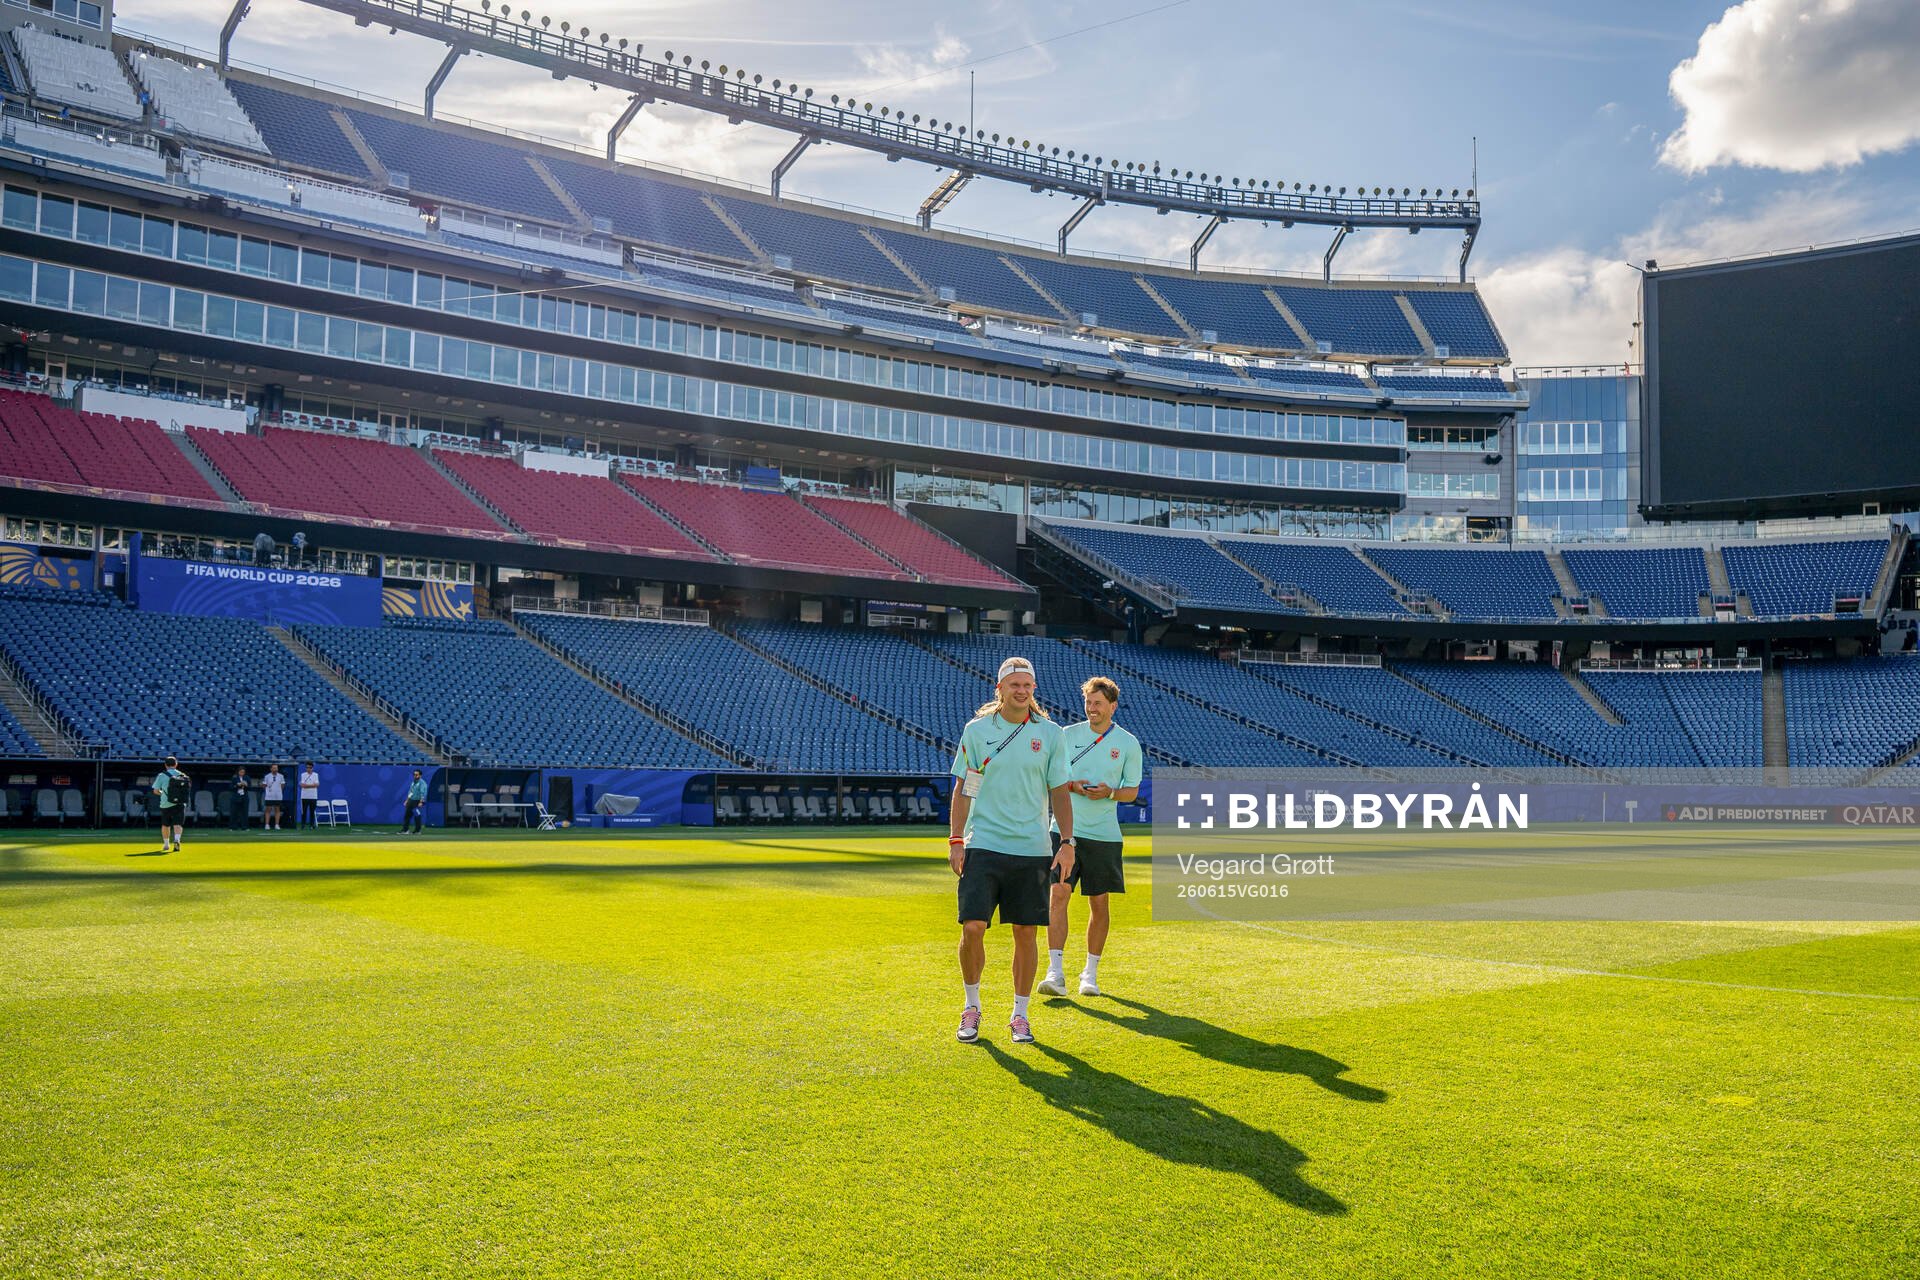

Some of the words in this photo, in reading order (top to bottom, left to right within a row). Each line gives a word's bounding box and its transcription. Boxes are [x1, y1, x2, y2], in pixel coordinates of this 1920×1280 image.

[186, 564, 215, 577] FIFA
[217, 567, 266, 581] WORLD
[268, 572, 294, 584] CUP
[296, 575, 342, 588] 2026
[1678, 807, 1714, 821] ADI
[1718, 808, 1827, 821] PREDICTSTREET
[1843, 806, 1916, 825] QATAR
